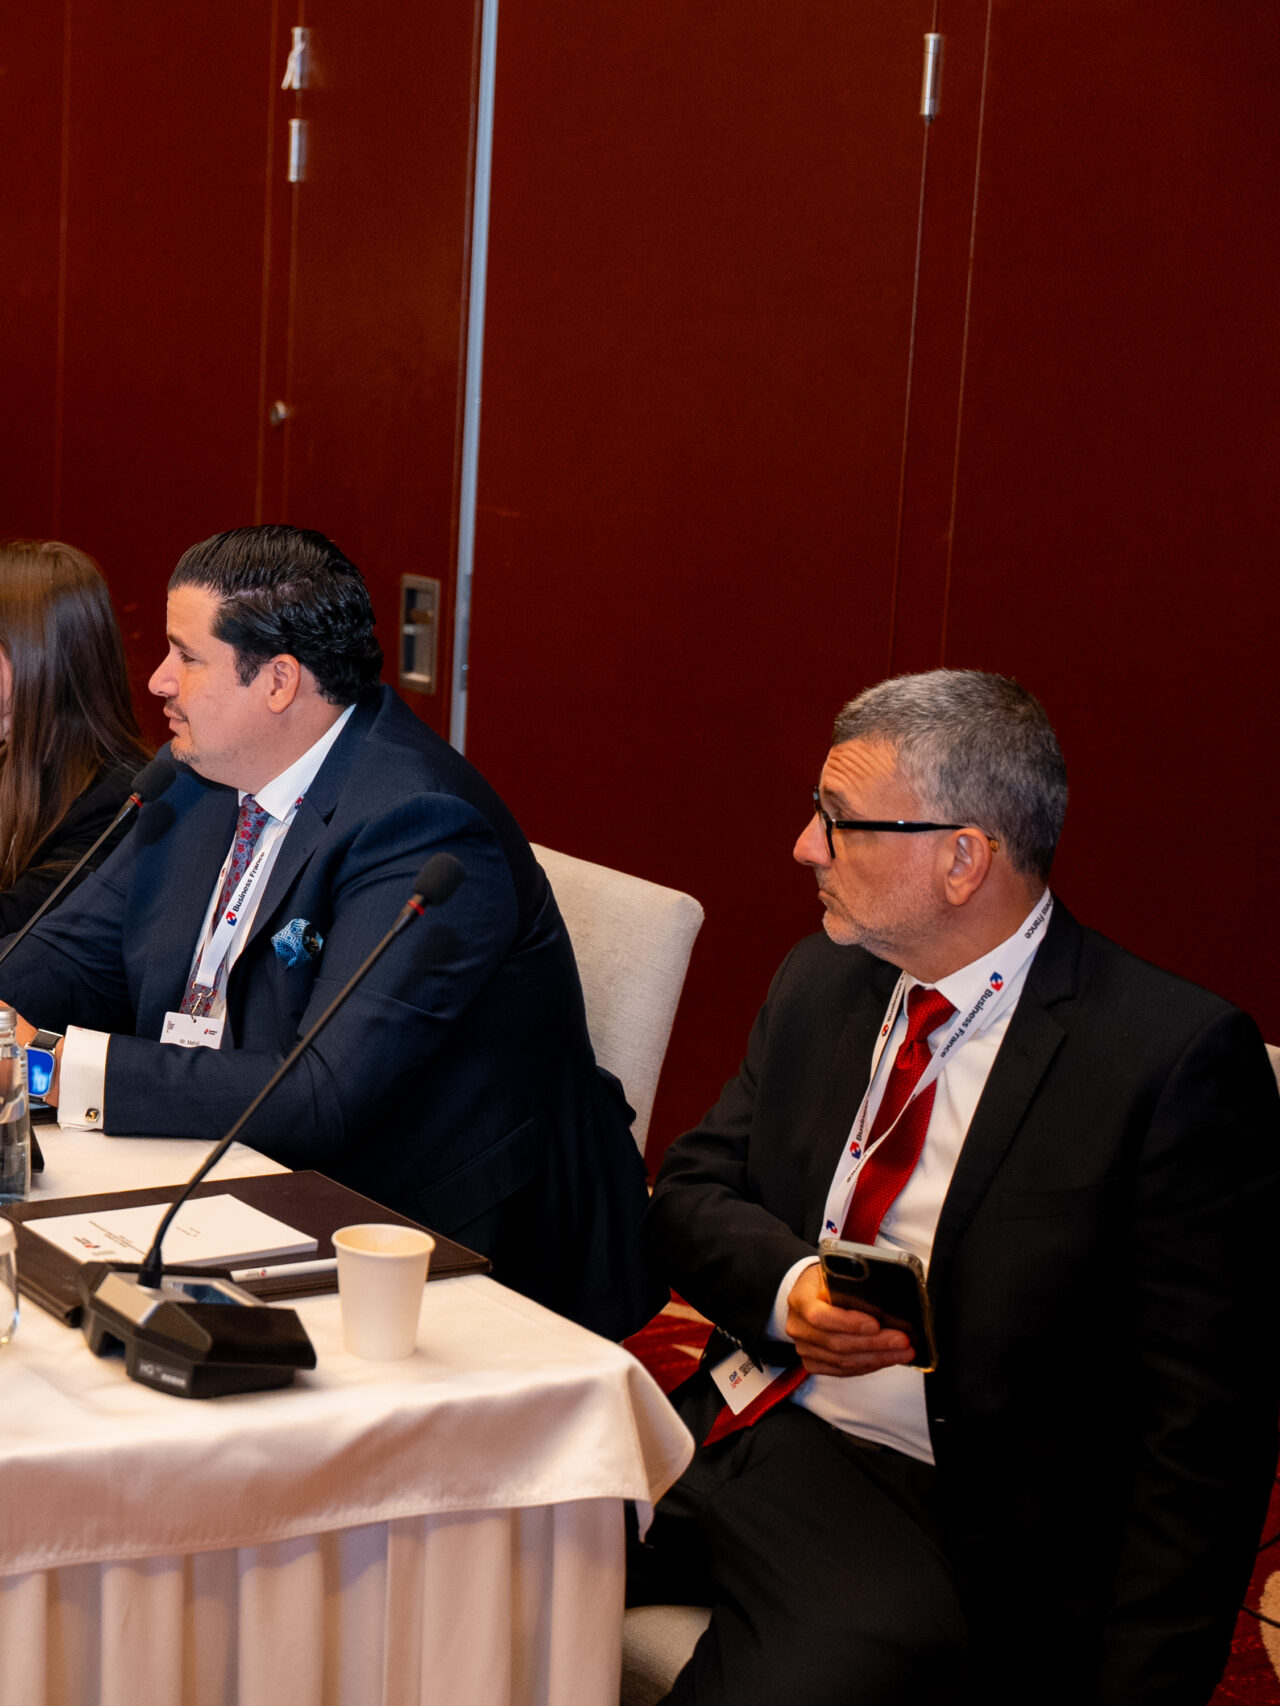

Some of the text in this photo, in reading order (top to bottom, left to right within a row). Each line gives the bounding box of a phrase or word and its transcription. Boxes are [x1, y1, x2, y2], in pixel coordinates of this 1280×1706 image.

[232, 851, 265, 913] Business France
[1024, 913, 1046, 939] France
[940, 988, 994, 1059] Business France
